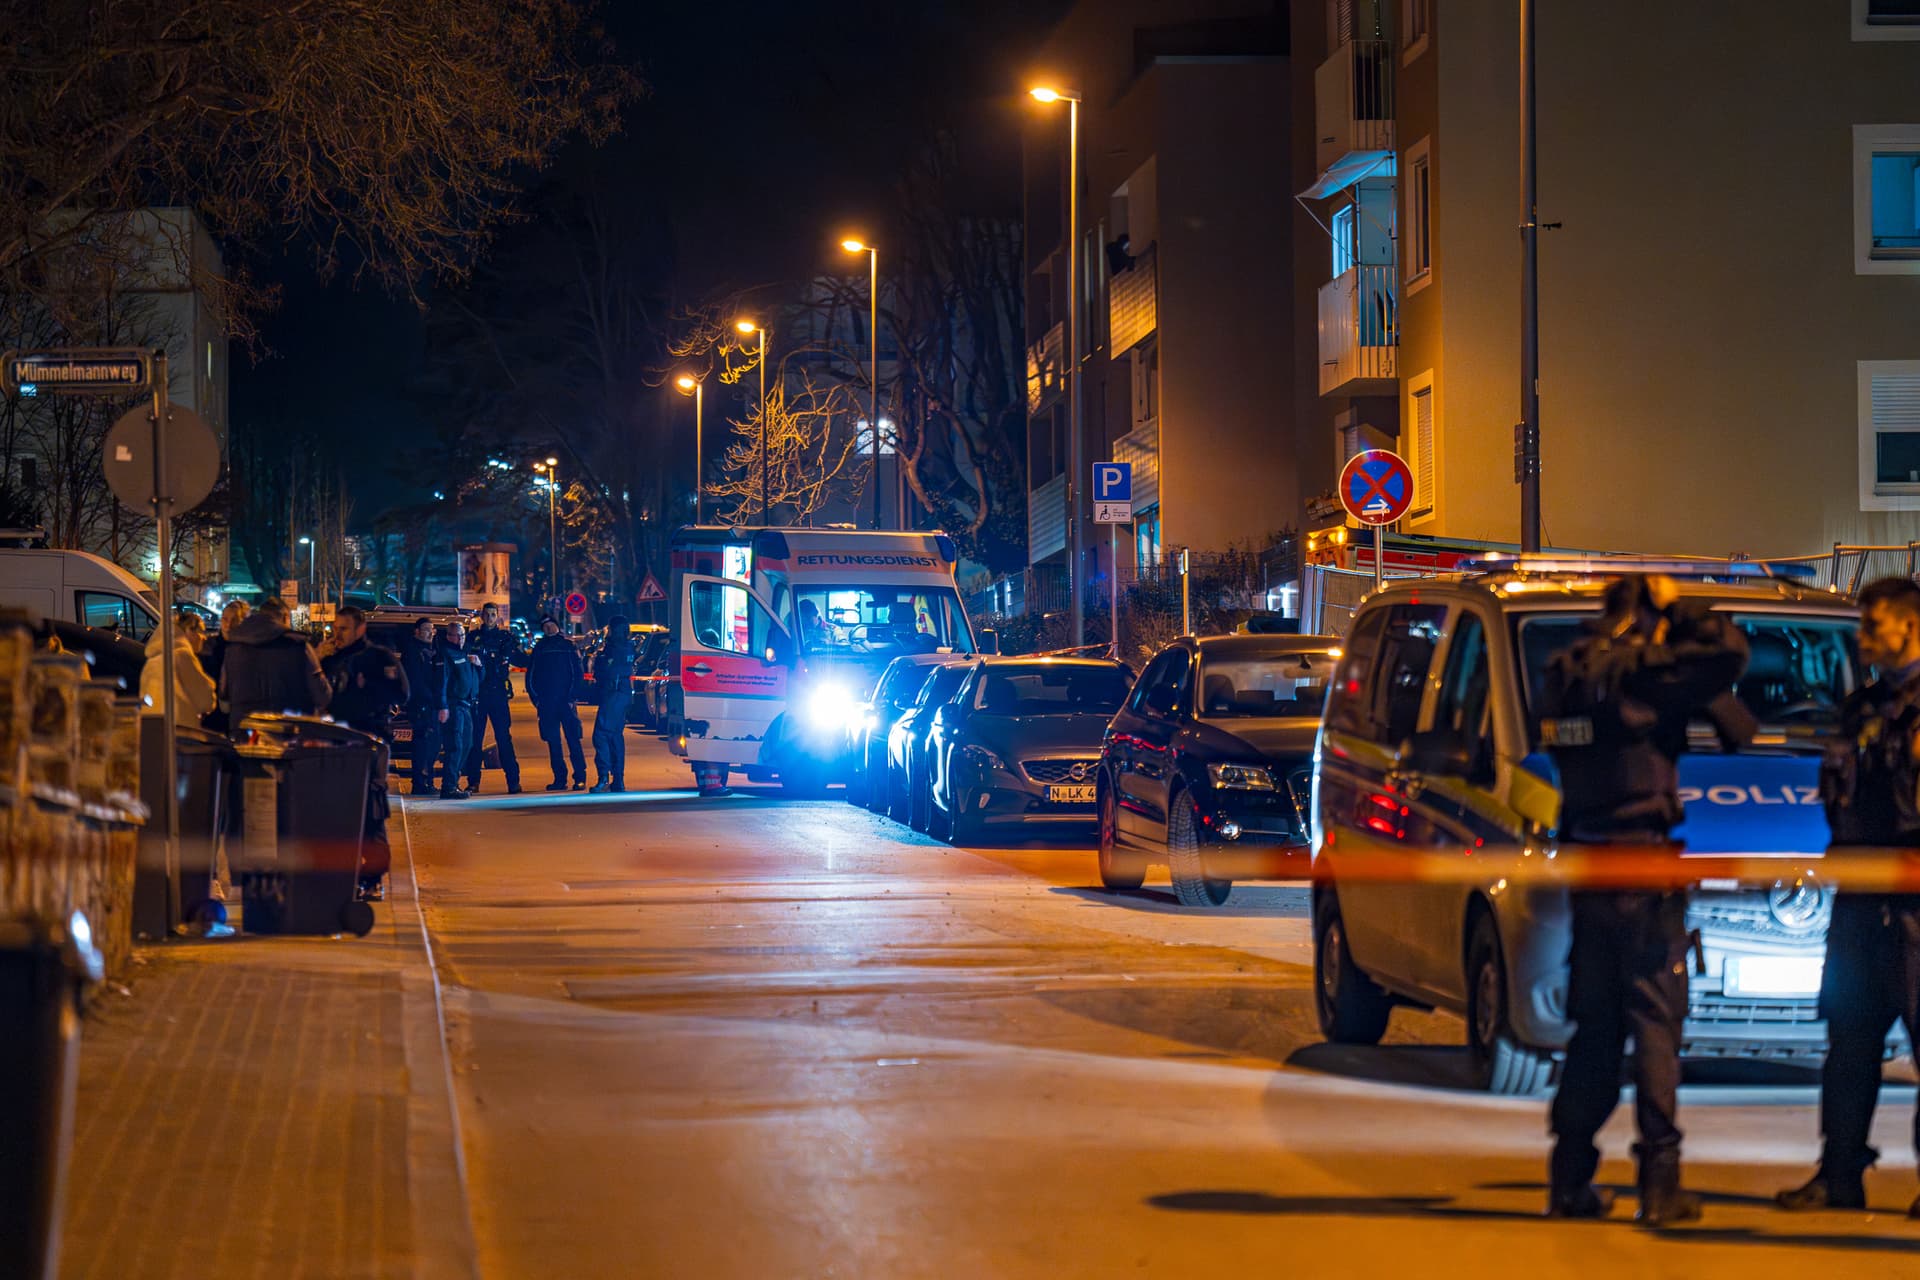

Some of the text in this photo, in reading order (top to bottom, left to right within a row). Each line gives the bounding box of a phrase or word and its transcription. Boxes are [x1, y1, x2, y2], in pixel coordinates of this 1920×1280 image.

[16, 362, 137, 383] Mümmelmannweg
[1102, 467, 1123, 497] P
[797, 554, 938, 567] RETTUNGSDIENST
[1052, 787, 1060, 799] N
[1068, 787, 1083, 799] LK
